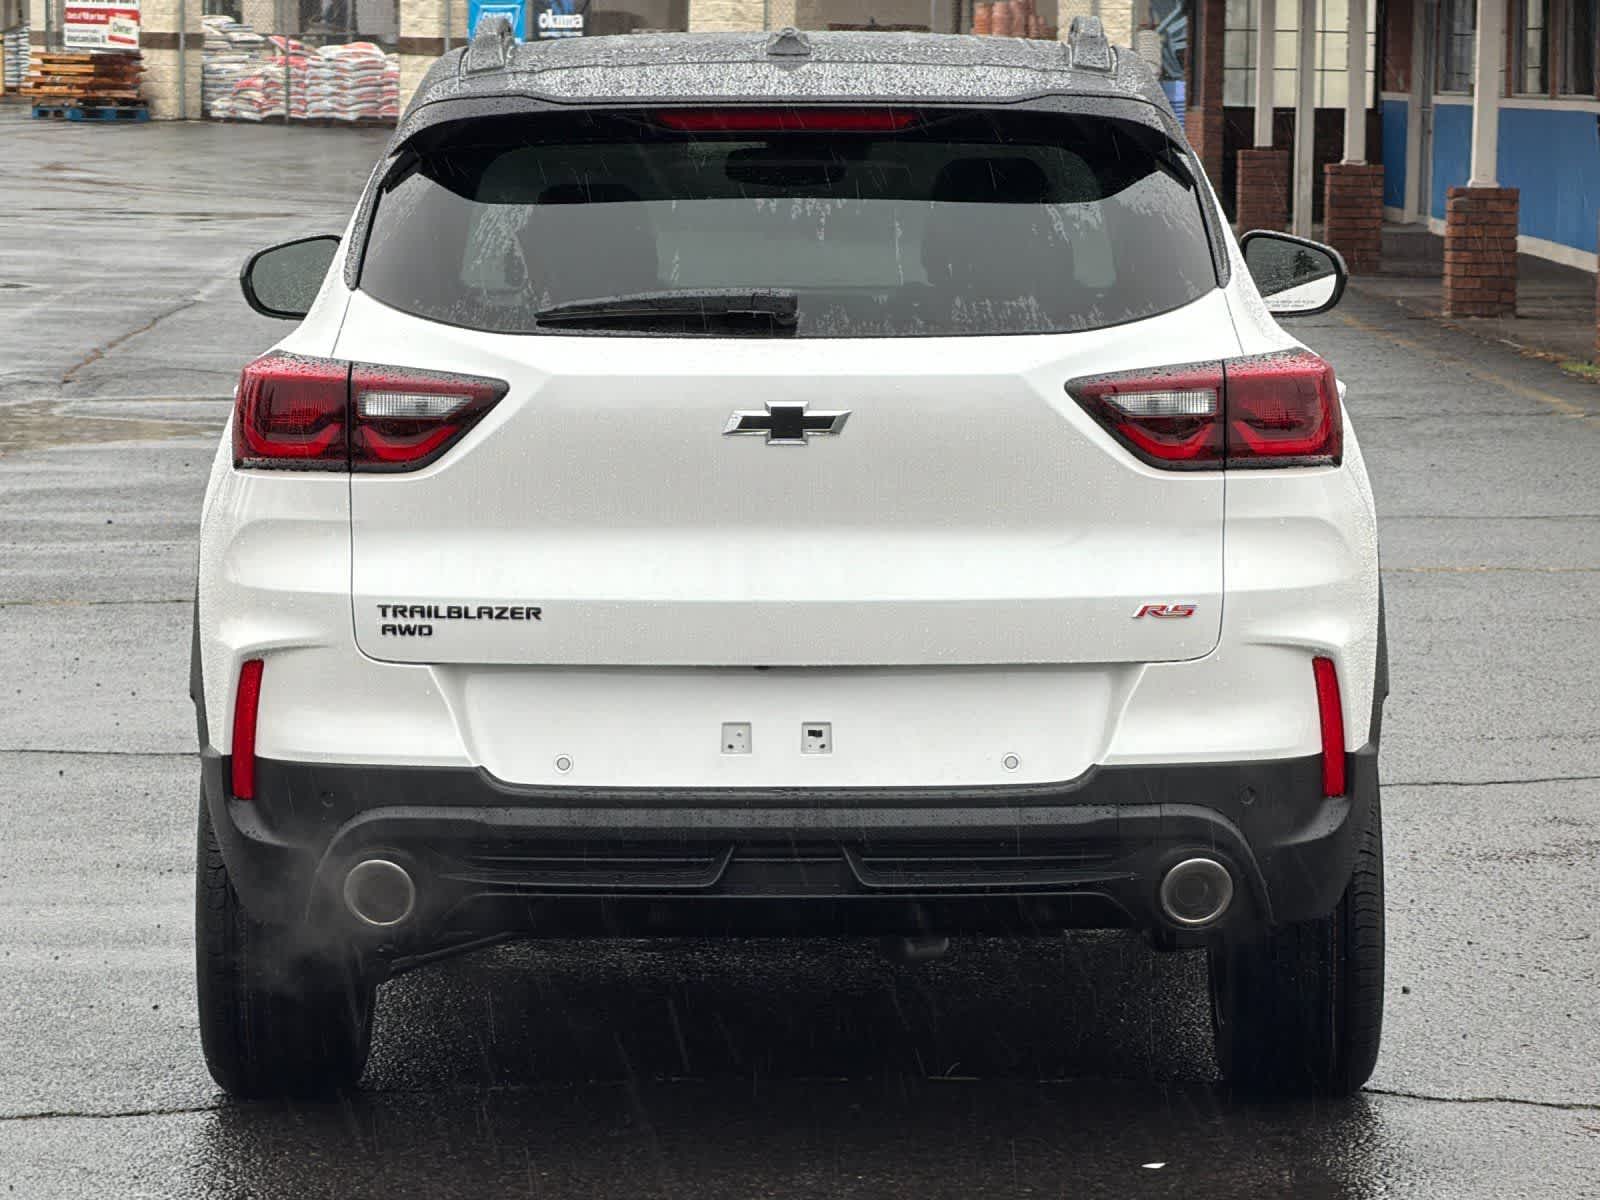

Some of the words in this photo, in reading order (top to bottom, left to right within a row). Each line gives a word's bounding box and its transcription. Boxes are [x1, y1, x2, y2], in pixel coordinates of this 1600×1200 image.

[377, 604, 542, 620] TRAILBLAZER
[1132, 604, 1197, 619] RS
[381, 623, 433, 636] AWD
